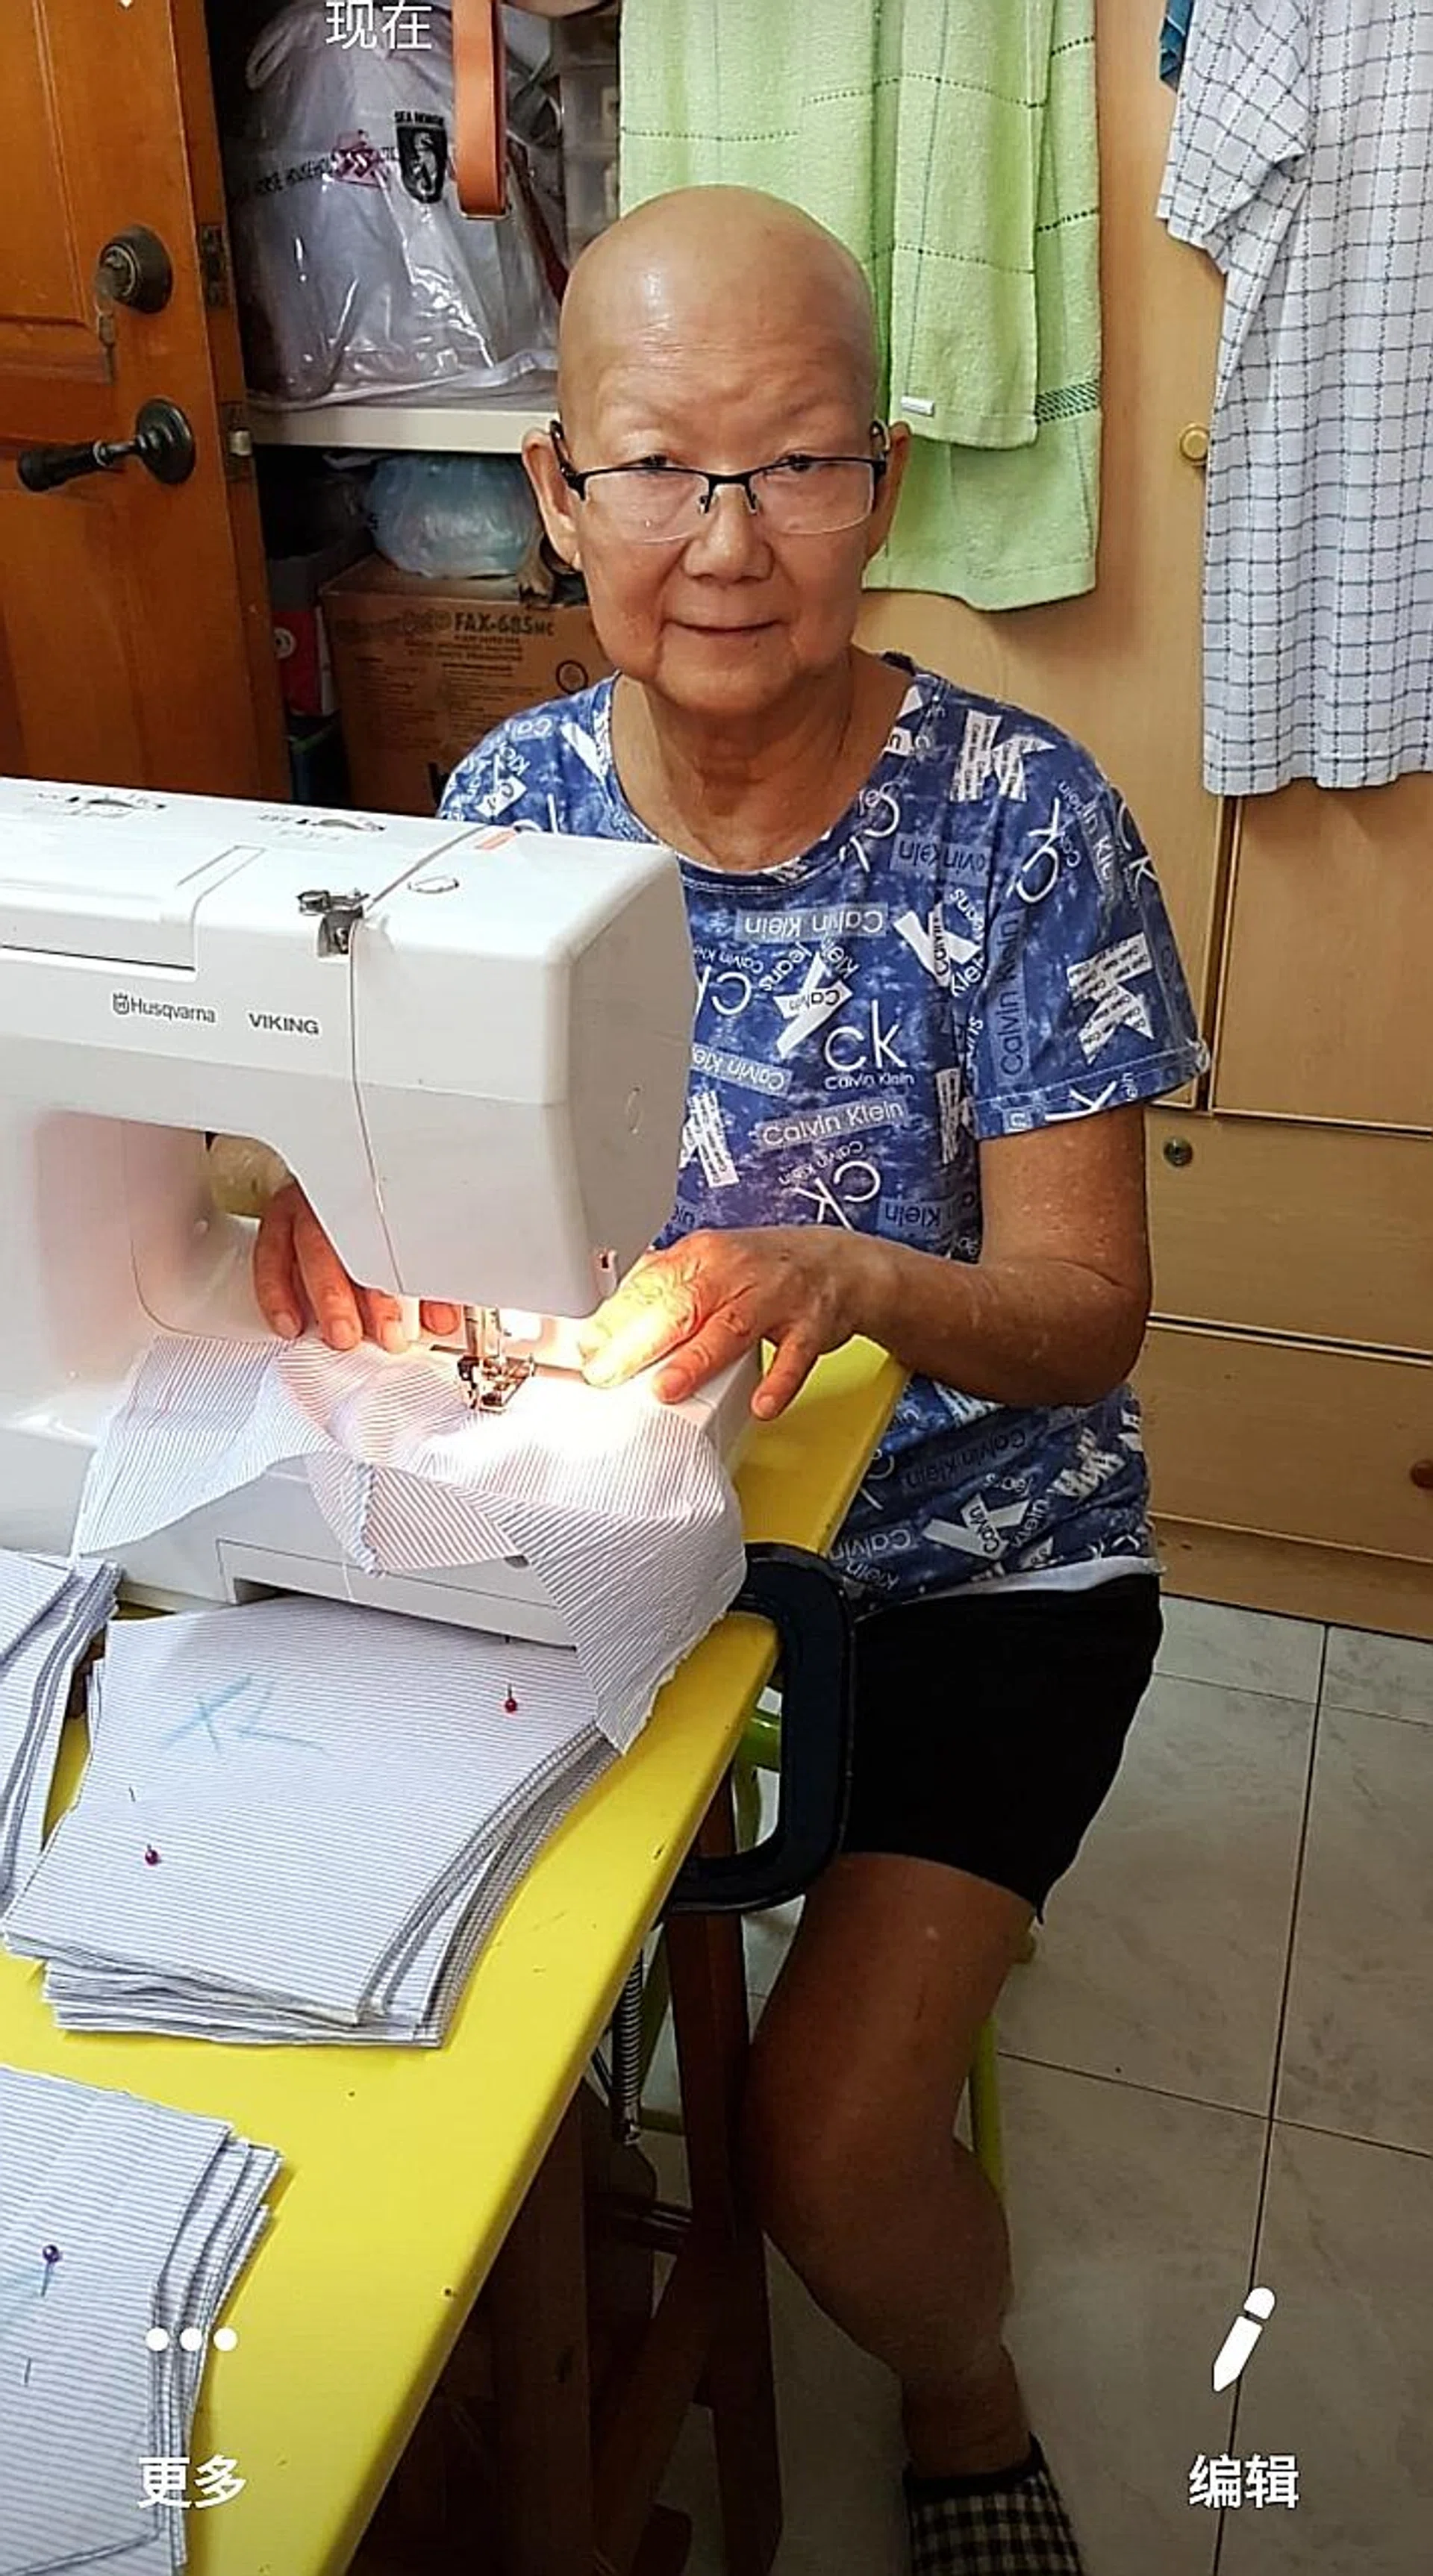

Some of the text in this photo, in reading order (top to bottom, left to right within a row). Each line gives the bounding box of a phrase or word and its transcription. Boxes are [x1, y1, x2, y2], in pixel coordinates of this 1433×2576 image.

[745, 910, 884, 939] Calvin Klein
[131, 997, 319, 1036] Husqvarna VIKING
[995, 990, 1024, 1076] Calvin
[728, 1057, 784, 1090] Calvin
[824, 1073, 875, 1091] Calvin
[762, 1101, 905, 1145] Calvin Klein
